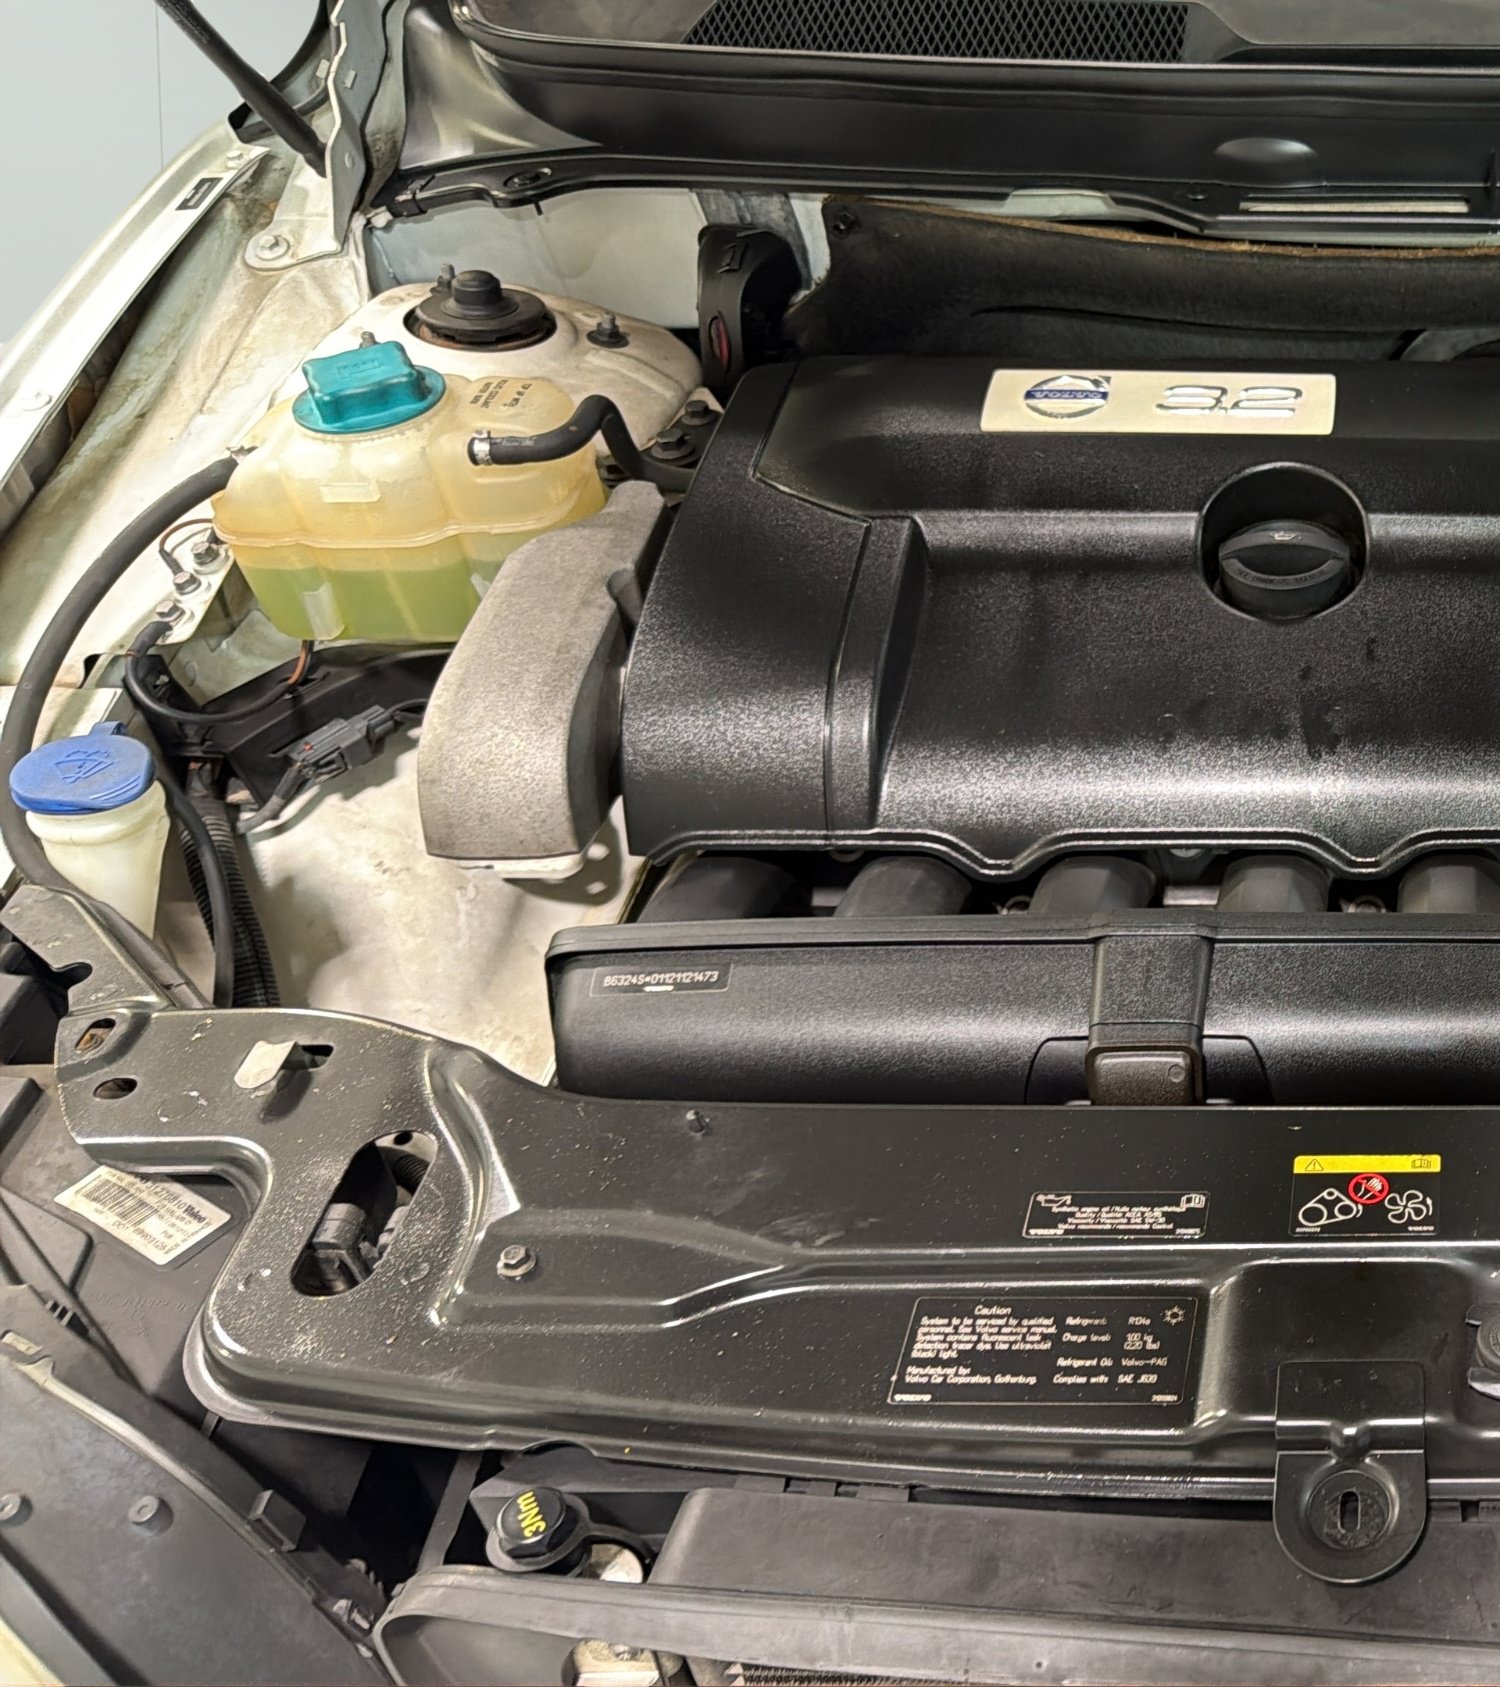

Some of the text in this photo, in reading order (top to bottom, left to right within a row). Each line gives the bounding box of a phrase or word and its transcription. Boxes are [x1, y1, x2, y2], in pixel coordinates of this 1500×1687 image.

[974, 1304, 1013, 1316] Caution
[920, 1315, 1055, 1327] System to be serviced by qualified
[1128, 1315, 1151, 1326] R134a
[957, 1325, 972, 1334] See
[975, 1325, 999, 1334] Volvo
[1001, 1325, 1028, 1334] service
[915, 1333, 1043, 1344] System contains fluorescent leak
[1062, 1332, 1087, 1343] Charge
[1143, 1333, 1153, 1343] kg
[913, 1342, 950, 1351] detection
[952, 1342, 975, 1351] tracer
[995, 1342, 1010, 1351] Use
[1012, 1341, 1053, 1351] ultraviolet
[1145, 1341, 1161, 1350] lbs)
[910, 1349, 958, 1360] (black) light.
[1057, 1356, 1098, 1368] Refrigerant
[906, 1365, 972, 1375] Manufactured by:
[904, 1374, 928, 1384] Volvo
[931, 1374, 945, 1384] Car
[1053, 1373, 1088, 1385] Complies
[1117, 1373, 1135, 1384] SAE
[516, 1490, 547, 1538] 3Nm
